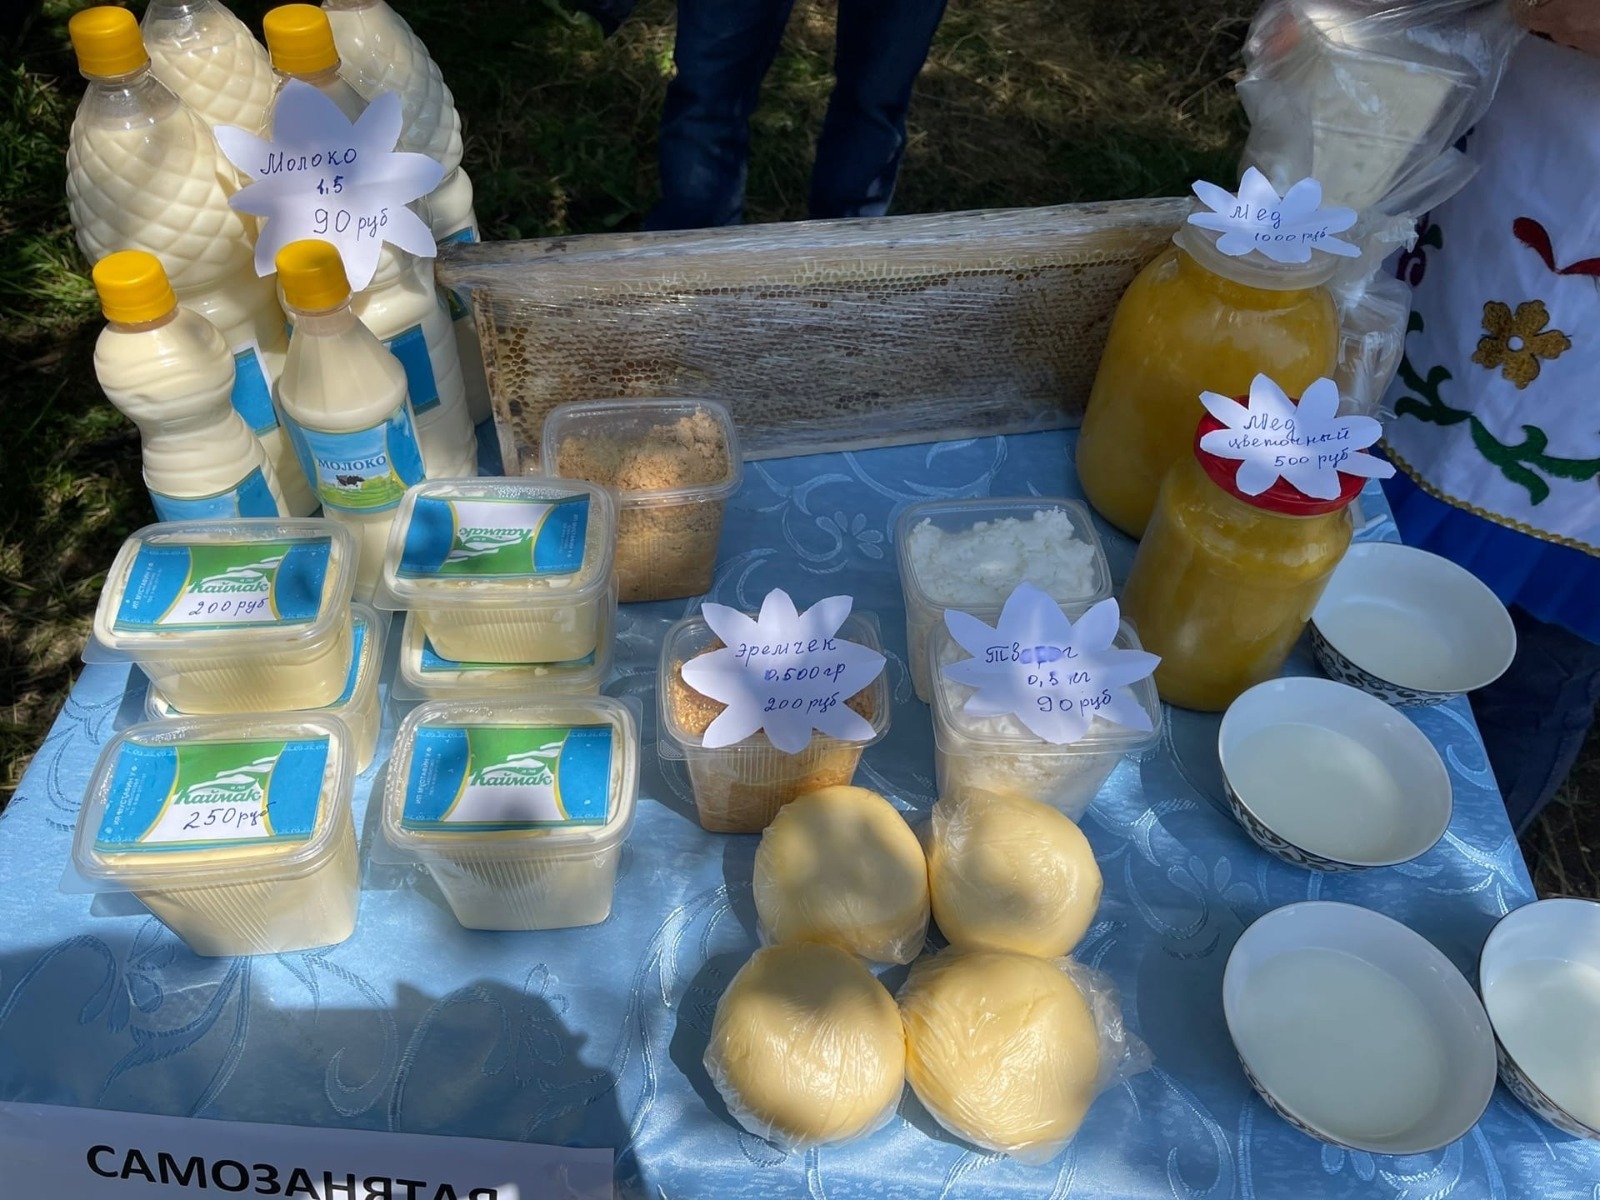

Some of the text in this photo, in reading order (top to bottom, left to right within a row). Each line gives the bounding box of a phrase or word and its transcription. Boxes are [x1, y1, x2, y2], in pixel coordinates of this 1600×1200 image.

[260, 148, 357, 175] Молоко
[313, 207, 389, 241] 90 руб
[1229, 204, 1282, 229] Мед
[1254, 232, 1296, 242] 1000
[1228, 427, 1350, 448] цветочный
[1243, 413, 1295, 441] Мед
[318, 455, 387, 471] МОЛОКО
[1274, 448, 1349, 469] 500 руб
[188, 597, 270, 617] 200 руб
[764, 691, 840, 715] 200 руб
[1037, 689, 1112, 717] 90 руб
